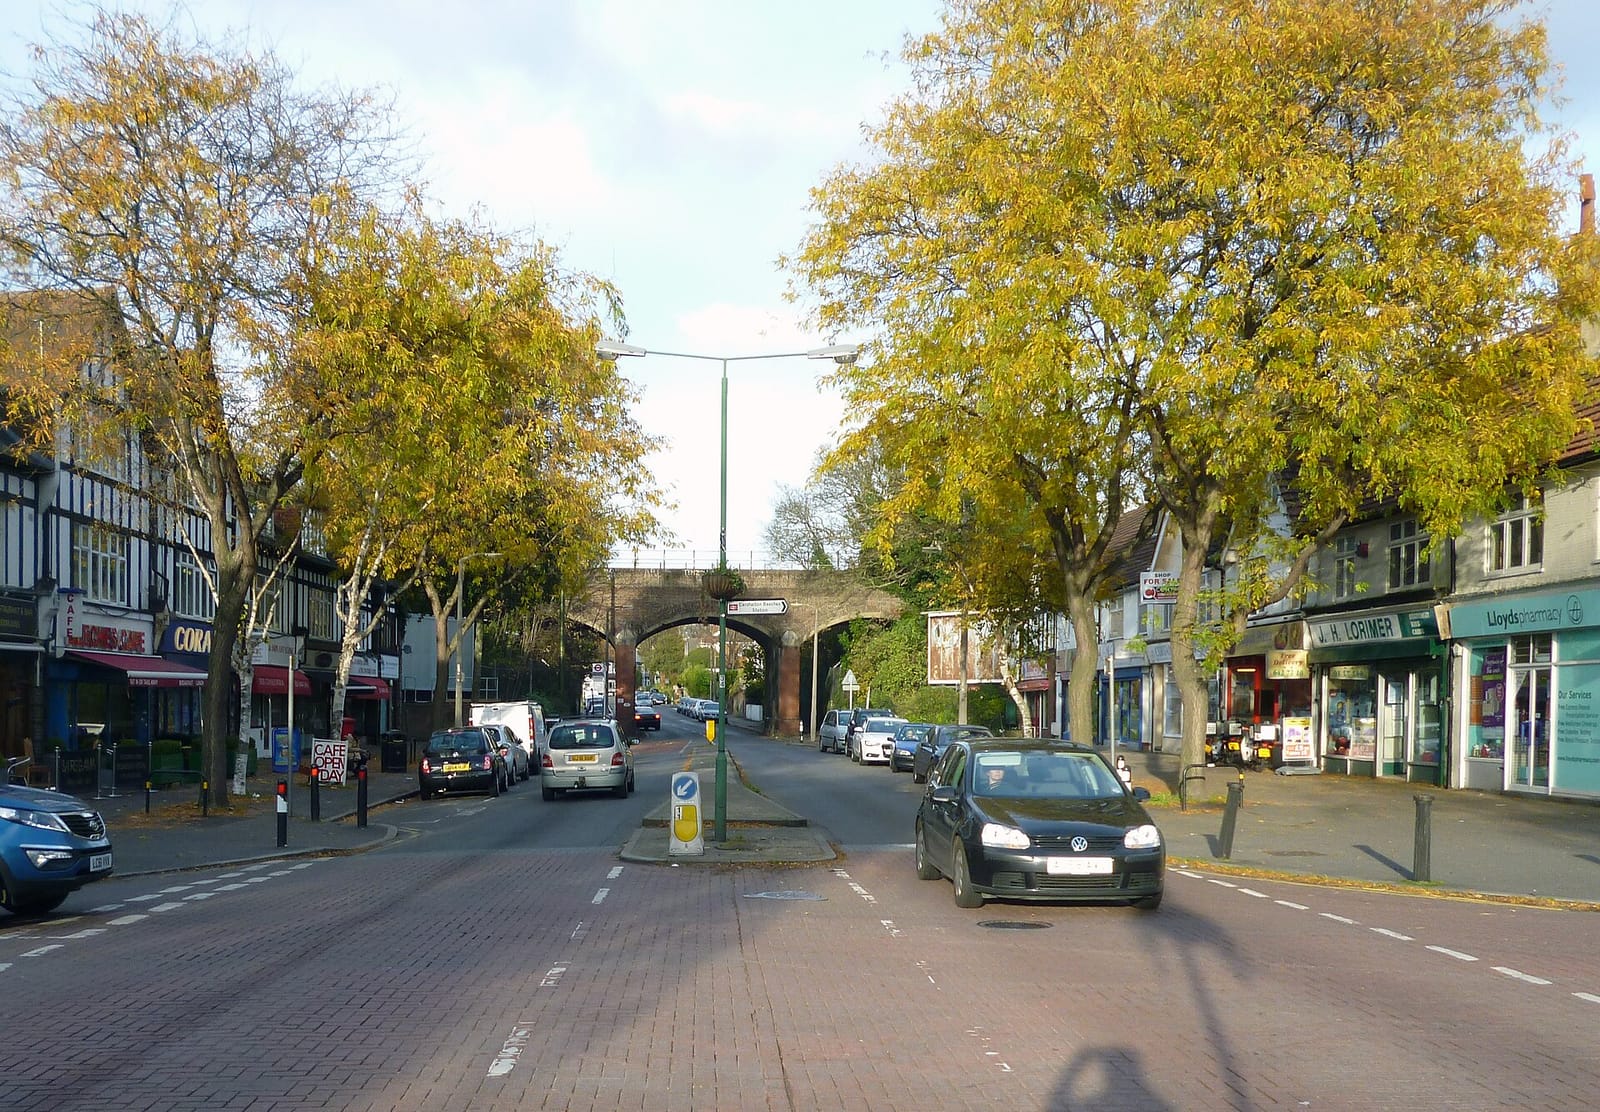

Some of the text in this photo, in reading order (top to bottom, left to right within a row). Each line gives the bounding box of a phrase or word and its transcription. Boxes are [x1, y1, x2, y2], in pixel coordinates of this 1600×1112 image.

[66, 593, 75, 637] CAFE
[1487, 608, 1562, 629] Lloydspharmacy
[1319, 617, 1394, 644] J. H. LORIMER
[1272, 659, 1305, 667] Delivery
[1558, 690, 1592, 699] Our Services
[314, 744, 346, 756] CAFE
[314, 757, 345, 769] OPEN
